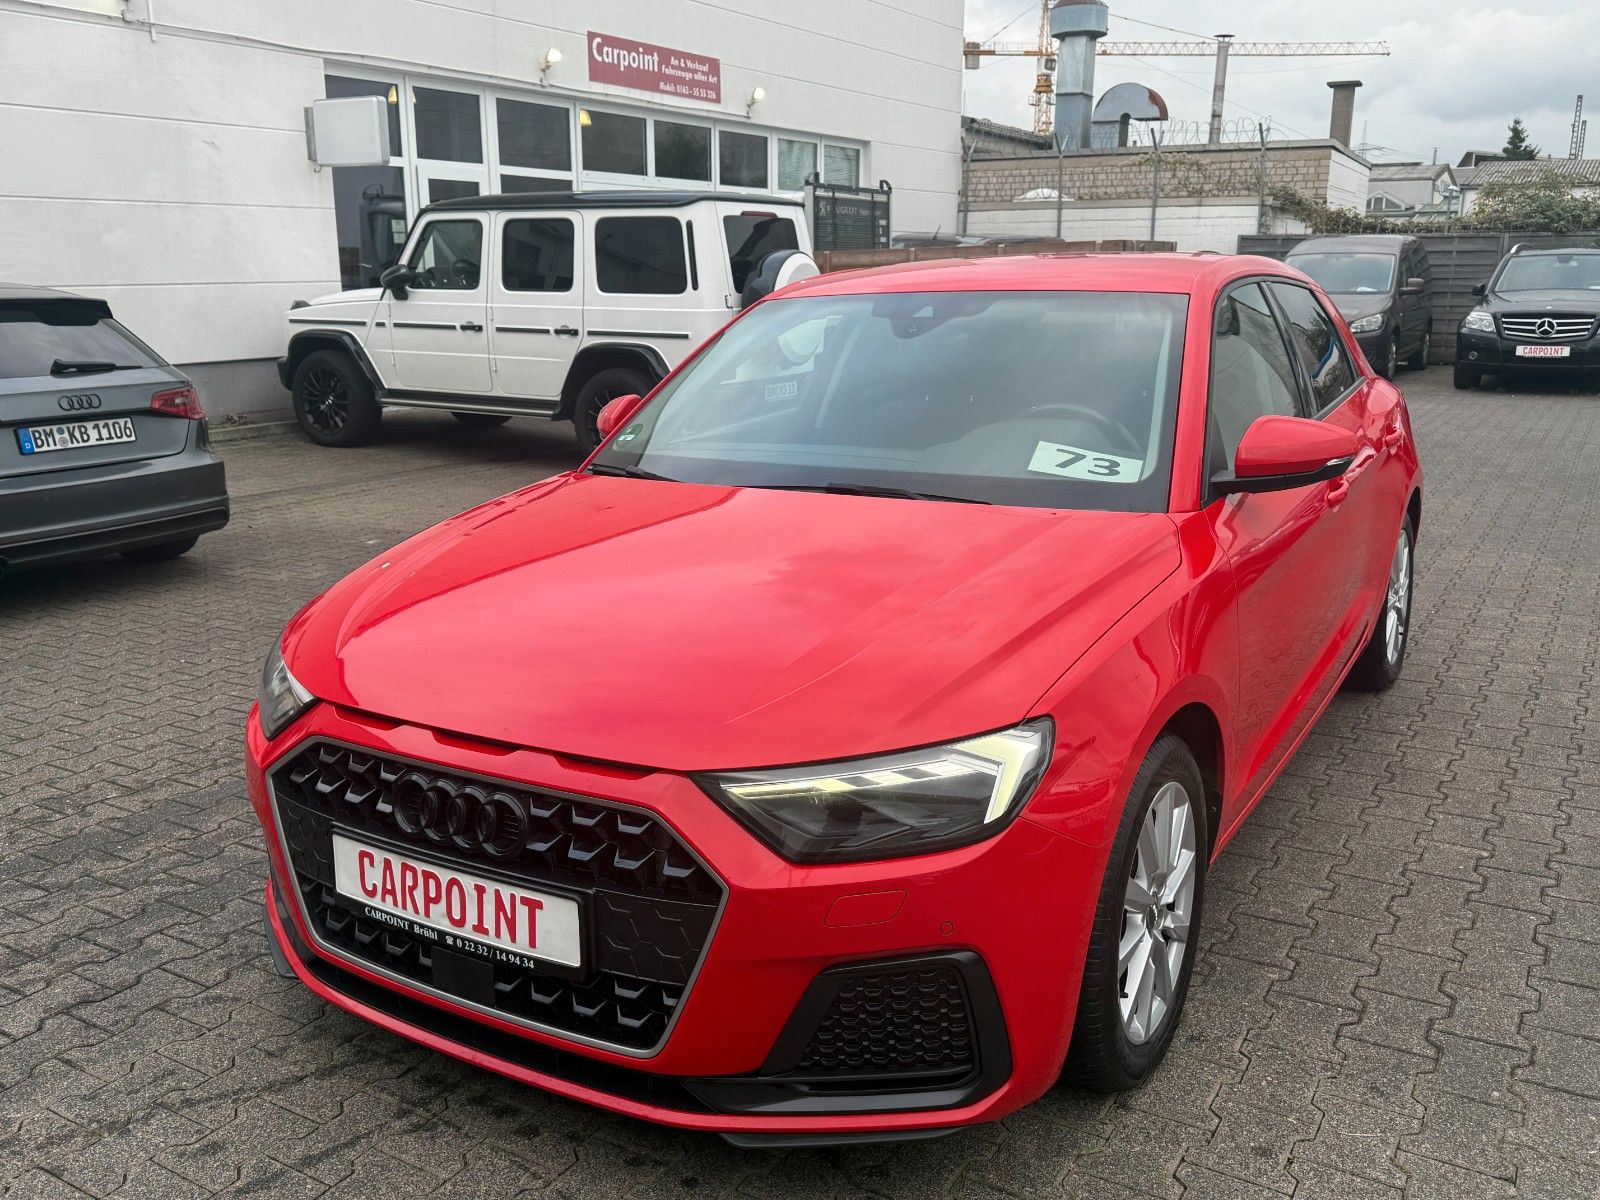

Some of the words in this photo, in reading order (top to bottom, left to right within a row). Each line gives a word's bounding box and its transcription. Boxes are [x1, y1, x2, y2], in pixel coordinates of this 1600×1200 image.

[592, 37, 659, 72] Carpoint
[670, 56, 679, 66] An
[680, 58, 685, 67] &
[686, 59, 709, 72] Verkauf
[661, 64, 693, 81] Fahrzeuge
[693, 71, 708, 82] aller
[708, 74, 718, 84] Art
[1522, 346, 1565, 356] CARPOINT
[31, 429, 58, 449] BM
[66, 425, 91, 444] KB
[92, 420, 133, 441] 1106
[1054, 448, 1121, 477] 73
[358, 849, 544, 949] CARPOINT
[365, 906, 410, 931] CARPOINT
[413, 923, 438, 940] Brühl
[456, 938, 462, 948] 0
[464, 940, 475, 952] 22
[476, 944, 488, 956] 32
[495, 950, 507, 962] 14
[508, 953, 521, 966] 94
[522, 957, 535, 969] 34
